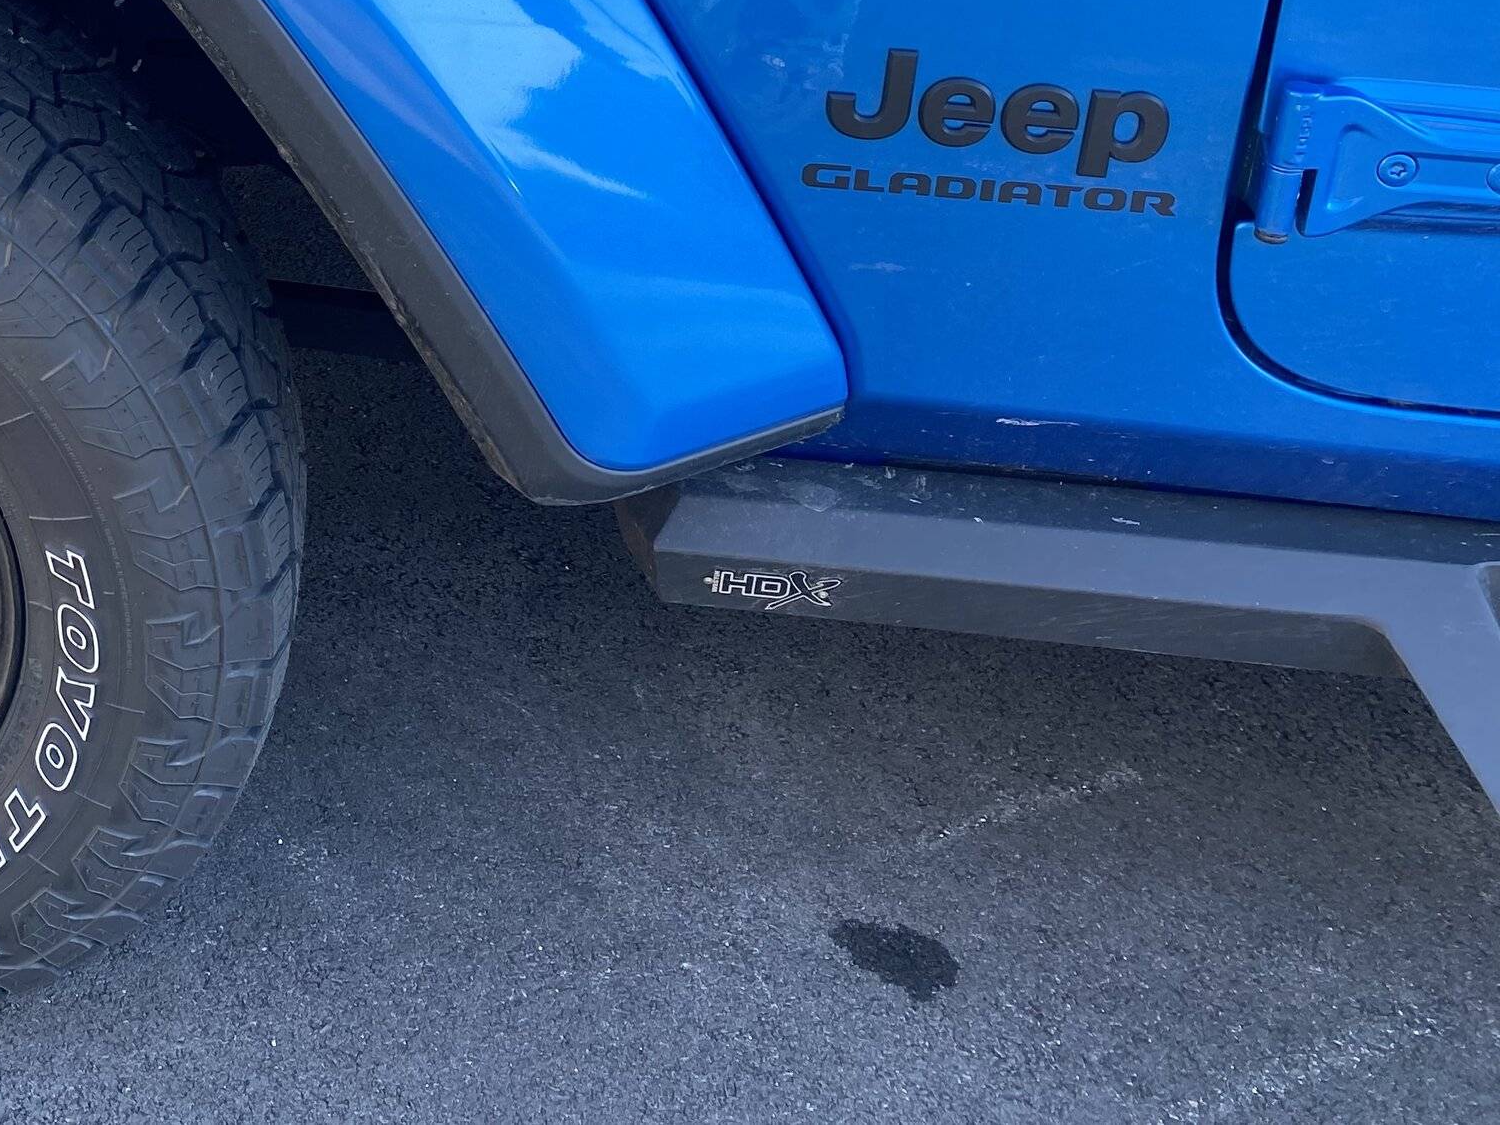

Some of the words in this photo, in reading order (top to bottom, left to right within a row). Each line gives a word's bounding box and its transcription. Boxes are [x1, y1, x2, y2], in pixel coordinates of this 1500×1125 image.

[825, 47, 1171, 178] Jeep
[800, 162, 1178, 217] GLADIATOR
[718, 571, 842, 610] HDX
[35, 548, 100, 792] TOYO
